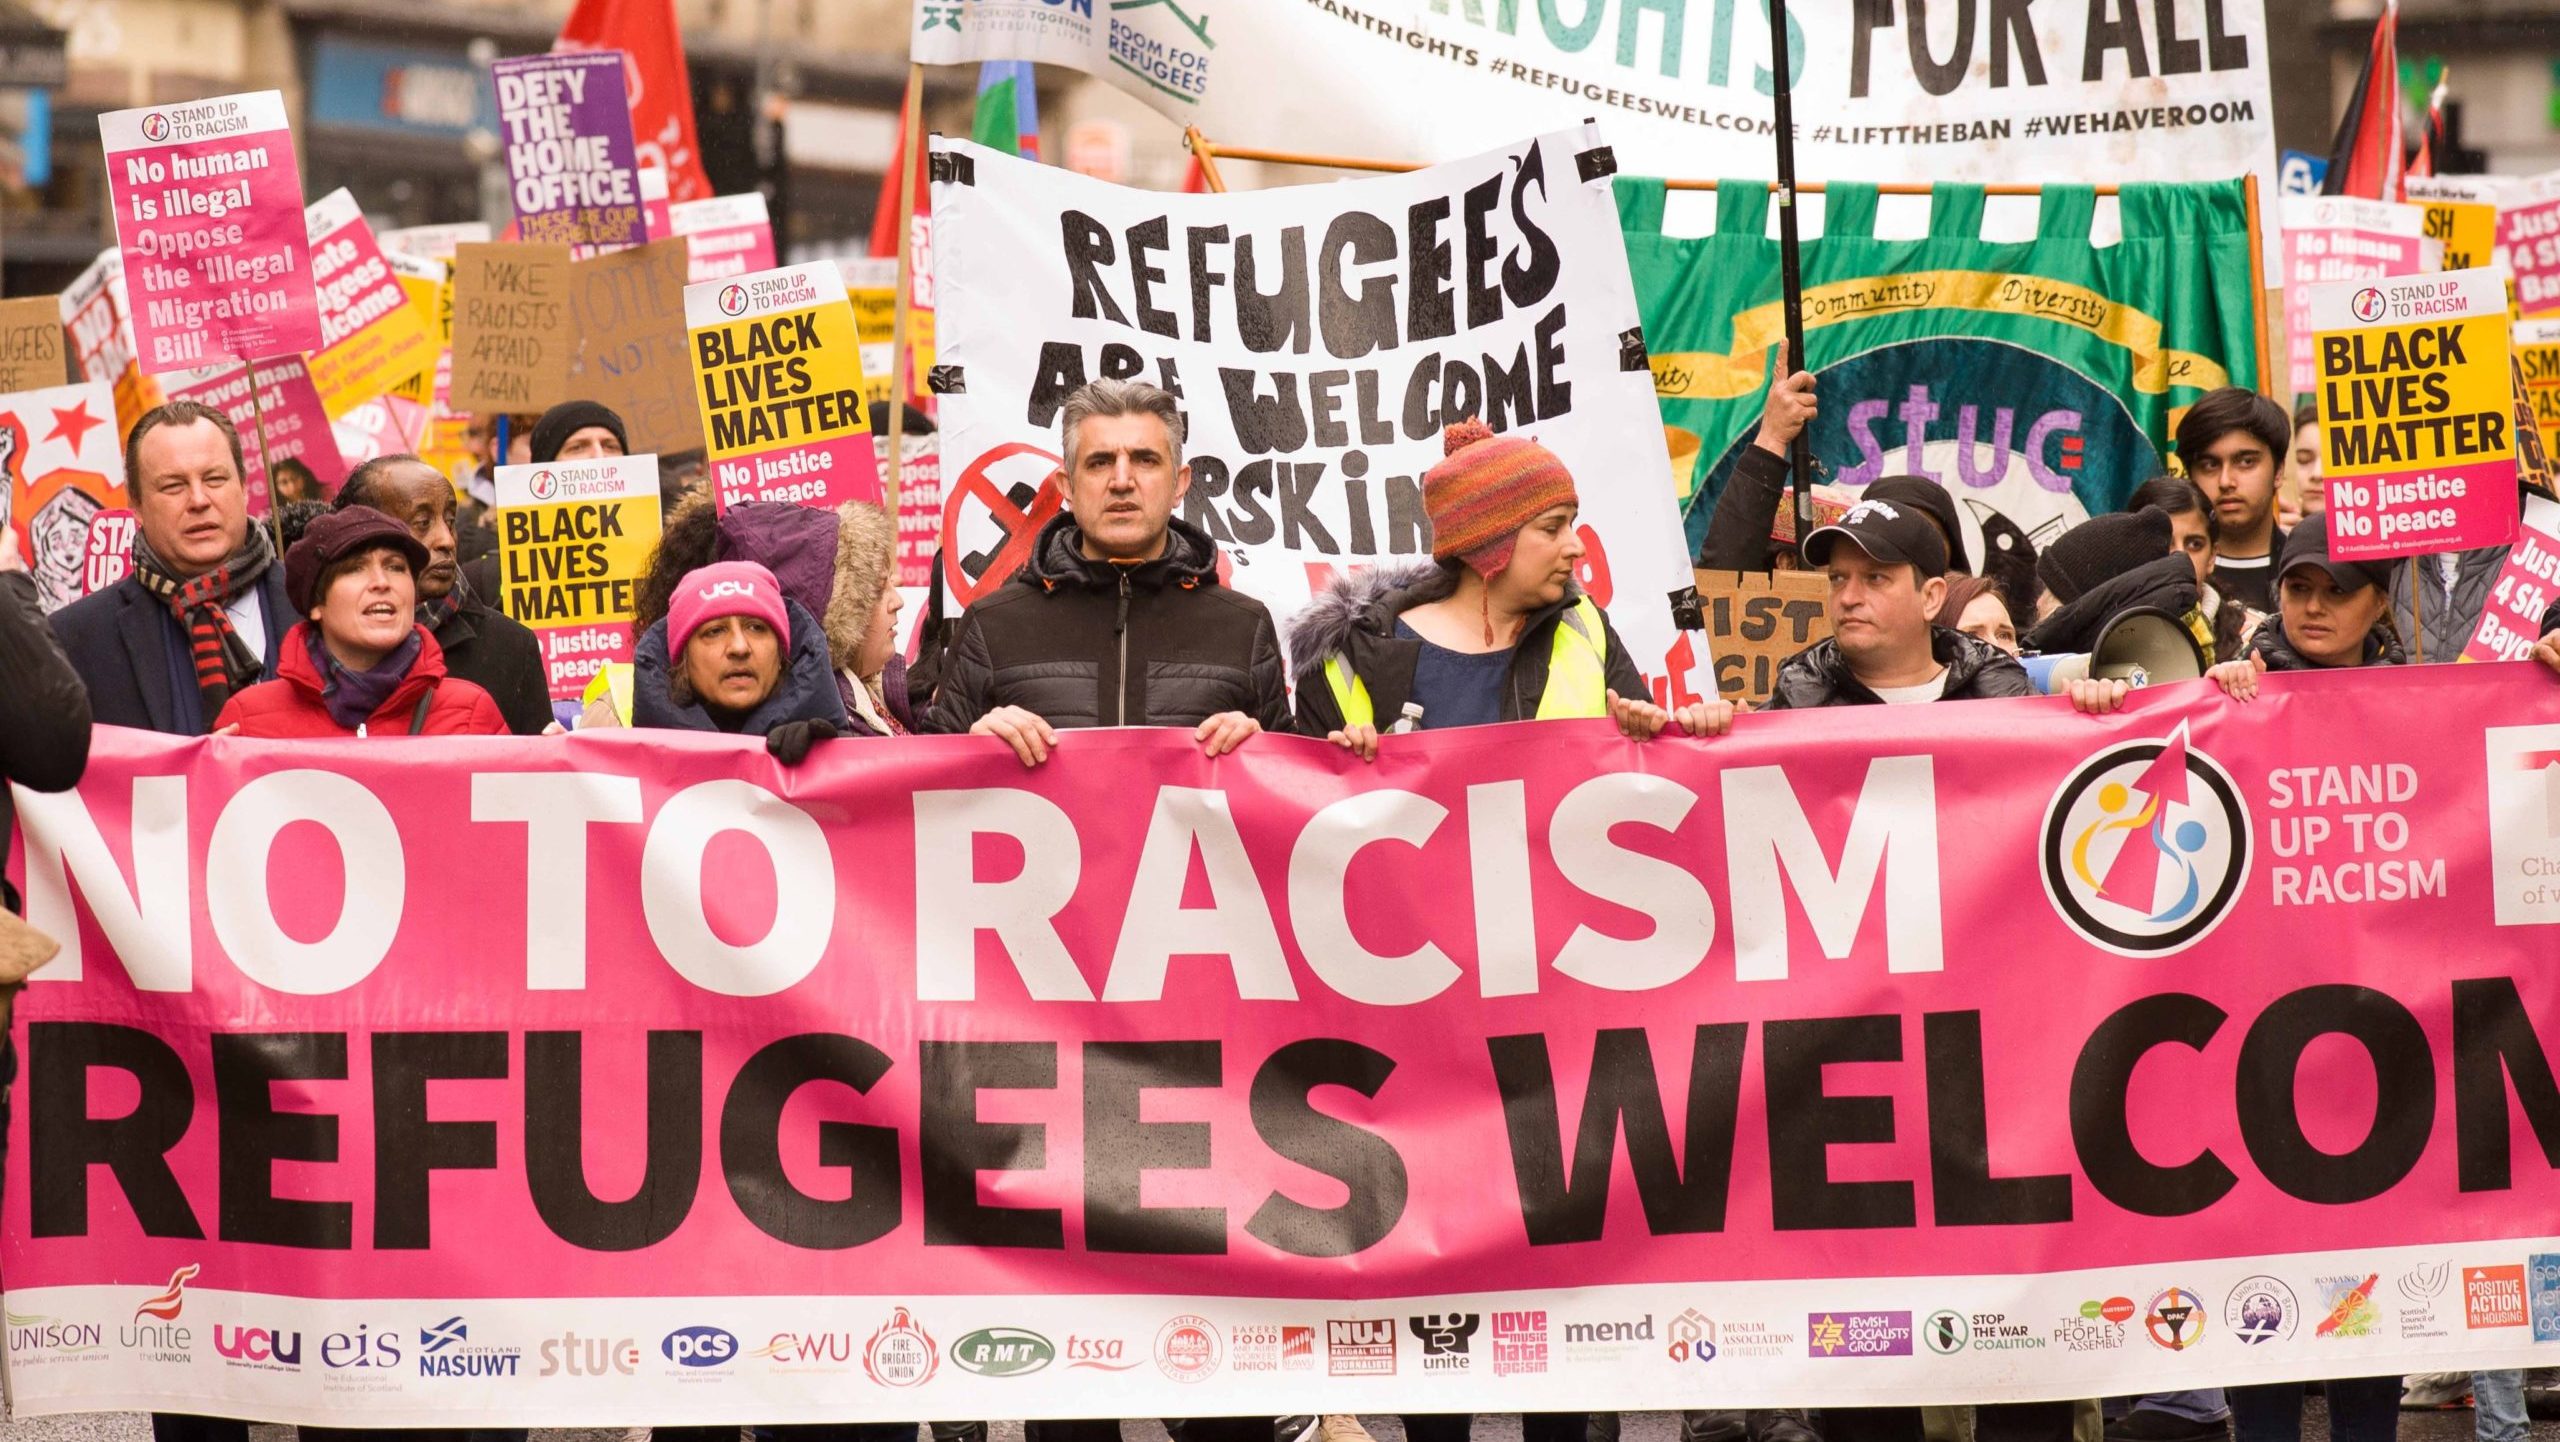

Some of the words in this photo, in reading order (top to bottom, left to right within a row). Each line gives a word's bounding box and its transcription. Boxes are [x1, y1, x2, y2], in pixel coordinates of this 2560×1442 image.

[1030, 10, 1091, 35] TOGETHER
[1110, 18, 1162, 58] ROOM
[1169, 47, 1209, 72] FOR
[1428, 0, 1806, 97] GHTS
[1850, 0, 2048, 98] FOR
[2082, 0, 2249, 82] ALL
[1109, 34, 1207, 94] REFUGEES
[497, 68, 587, 111] DEFY
[172, 106, 216, 125] STAND
[219, 102, 238, 117] UP
[174, 125, 192, 140] TO
[195, 116, 249, 138] RACISM
[503, 104, 575, 144] THE
[1812, 117, 2011, 146] #LIFTTHEBAN
[2023, 100, 2254, 138] #WEHAVEROOM
[126, 157, 165, 186] No
[171, 147, 269, 180] human
[509, 135, 614, 180] HOME
[131, 194, 158, 221] is
[163, 179, 252, 218] illegal
[516, 168, 636, 214] OFFICE
[521, 209, 574, 235] THESE
[2508, 206, 2560, 242] Jus
[137, 223, 243, 260] Oppose
[2331, 231, 2402, 262] human
[142, 264, 190, 292] the
[483, 259, 552, 296] MAKE
[751, 277, 789, 296] STAND
[790, 274, 807, 288] UP
[2390, 284, 2435, 302] STAND
[2439, 282, 2459, 297] UP
[147, 288, 287, 329] Migration
[753, 296, 770, 310] TO
[773, 286, 816, 307] RACISM
[1800, 278, 1937, 320] Community
[2002, 280, 2107, 328] Diversity
[2392, 303, 2411, 318] TO
[2415, 296, 2468, 316] RACISM
[467, 298, 562, 331] RACISTS
[470, 334, 543, 368] AFRAID
[697, 312, 823, 370] BLACK
[2323, 324, 2467, 377] BLACK
[469, 370, 531, 403] AGAIN
[704, 357, 812, 411] LIVES
[1217, 302, 1572, 454] WELCOME
[2326, 372, 2450, 422] LIVES
[710, 389, 862, 451] MATTER
[2329, 411, 2506, 468] MATTER
[561, 469, 598, 483] STAND
[602, 467, 618, 479] UP
[719, 464, 750, 488] No
[756, 449, 832, 487] justice
[562, 484, 577, 496] TO
[580, 480, 625, 494] RACISM
[760, 479, 827, 502] peace
[2333, 481, 2370, 509] No
[2376, 474, 2467, 512] justice
[506, 503, 624, 546] BLACK
[2335, 511, 2373, 537] No
[2379, 507, 2457, 541] peace
[88, 554, 125, 592] UP
[508, 542, 610, 584] LIVES
[2494, 575, 2516, 606] 4
[2509, 582, 2549, 624] Sh
[548, 628, 623, 660] justice
[2268, 763, 2419, 809] STAND
[2270, 814, 2329, 858] UP
[2342, 812, 2409, 853] TO
[14, 768, 405, 995] NO
[470, 771, 836, 997] TO
[912, 754, 1944, 1006] RACISM
[2271, 859, 2448, 907] RACISM
[2523, 884, 2546, 905] of
[28, 1020, 1408, 1259] REFUGEES
[2468, 1279, 2520, 1296] POSITIVE
[2167, 1313, 2185, 1321] DPAC
[2471, 1294, 2522, 1313] ACTION
[2471, 1313, 2480, 1325] IN
[2482, 1311, 2523, 1324] HOUSING
[1232, 1325, 1278, 1334] BAKERS
[1330, 1320, 1393, 1345] NUJ
[1565, 1314, 1655, 1343] mend
[1722, 1322, 1765, 1333] MUSLIM
[1849, 1315, 1889, 1328] JEWISH
[1972, 1314, 2005, 1325] STOP
[1973, 1327, 1999, 1337] THE
[2001, 1326, 2028, 1337] WAR
[2060, 1316, 2084, 1328] THE
[10, 1323, 101, 1351] UNISON
[120, 1323, 192, 1349] unite
[321, 1324, 402, 1368] eis
[458, 1346, 521, 1354] SCOTLAND
[672, 1333, 732, 1366] pcs
[768, 1333, 850, 1363] CWU
[892, 1338, 911, 1351] FIRE
[1066, 1334, 1124, 1360] tssa
[1232, 1334, 1278, 1345] FOOD
[1723, 1333, 1794, 1344] ASSOCIATION
[1849, 1340, 1890, 1353] GROUP
[1974, 1337, 2046, 1351] COALITION
[2068, 1337, 2125, 1352] ASSEMBLY
[881, 1352, 922, 1365] BRIGADES
[973, 1343, 1035, 1363] RMT
[1331, 1347, 1367, 1356] NATIONAL
[1370, 1346, 1393, 1355] UNION
[1423, 1353, 1470, 1370] unite
[1722, 1346, 1735, 1357] OF
[1738, 1345, 1784, 1357] BRITAIN
[419, 1355, 520, 1377] NASUWT
[888, 1365, 915, 1379] UNION
[1232, 1361, 1278, 1372] UNION
